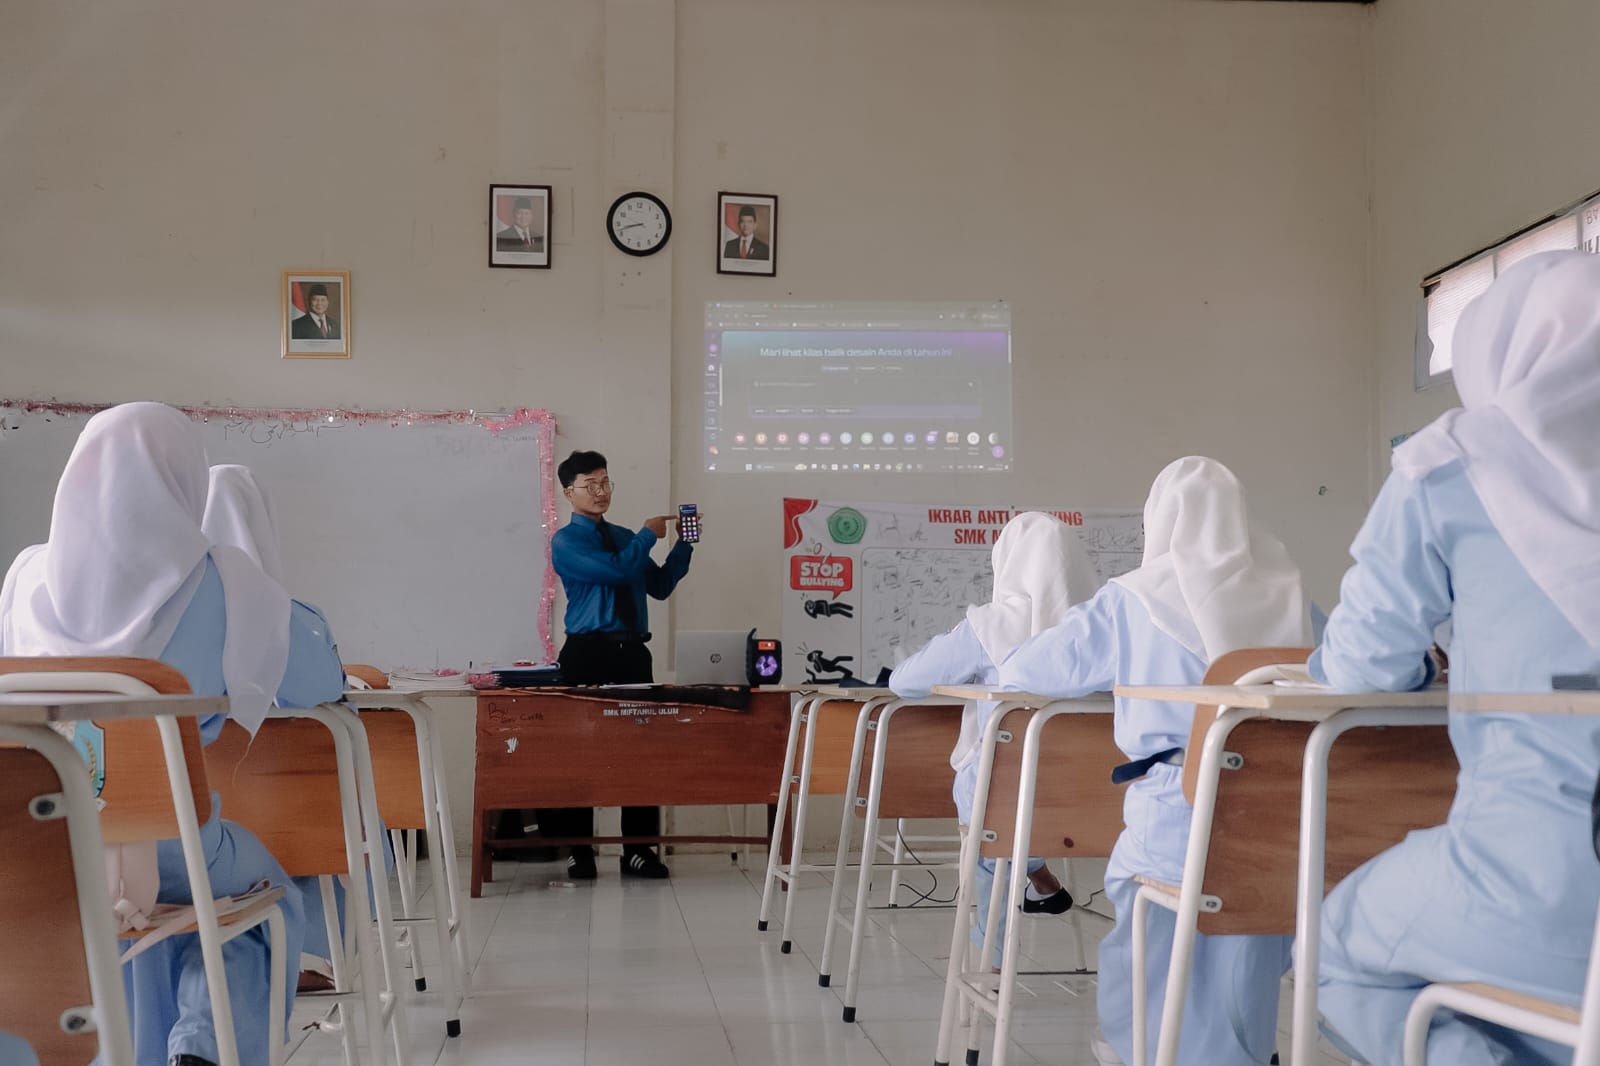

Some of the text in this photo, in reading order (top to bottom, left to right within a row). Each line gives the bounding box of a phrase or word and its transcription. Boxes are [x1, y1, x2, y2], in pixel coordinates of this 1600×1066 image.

[759, 347, 953, 357] Mari lihat kilas balik desain Anda di tahun ini
[928, 508, 972, 523] IKRAR
[978, 510, 1010, 524] ANTI
[954, 527, 987, 544] SMK
[800, 560, 844, 577] STOP
[799, 577, 844, 587] BULLYING
[603, 708, 680, 717] SMK MIFTAHUL ULUM
